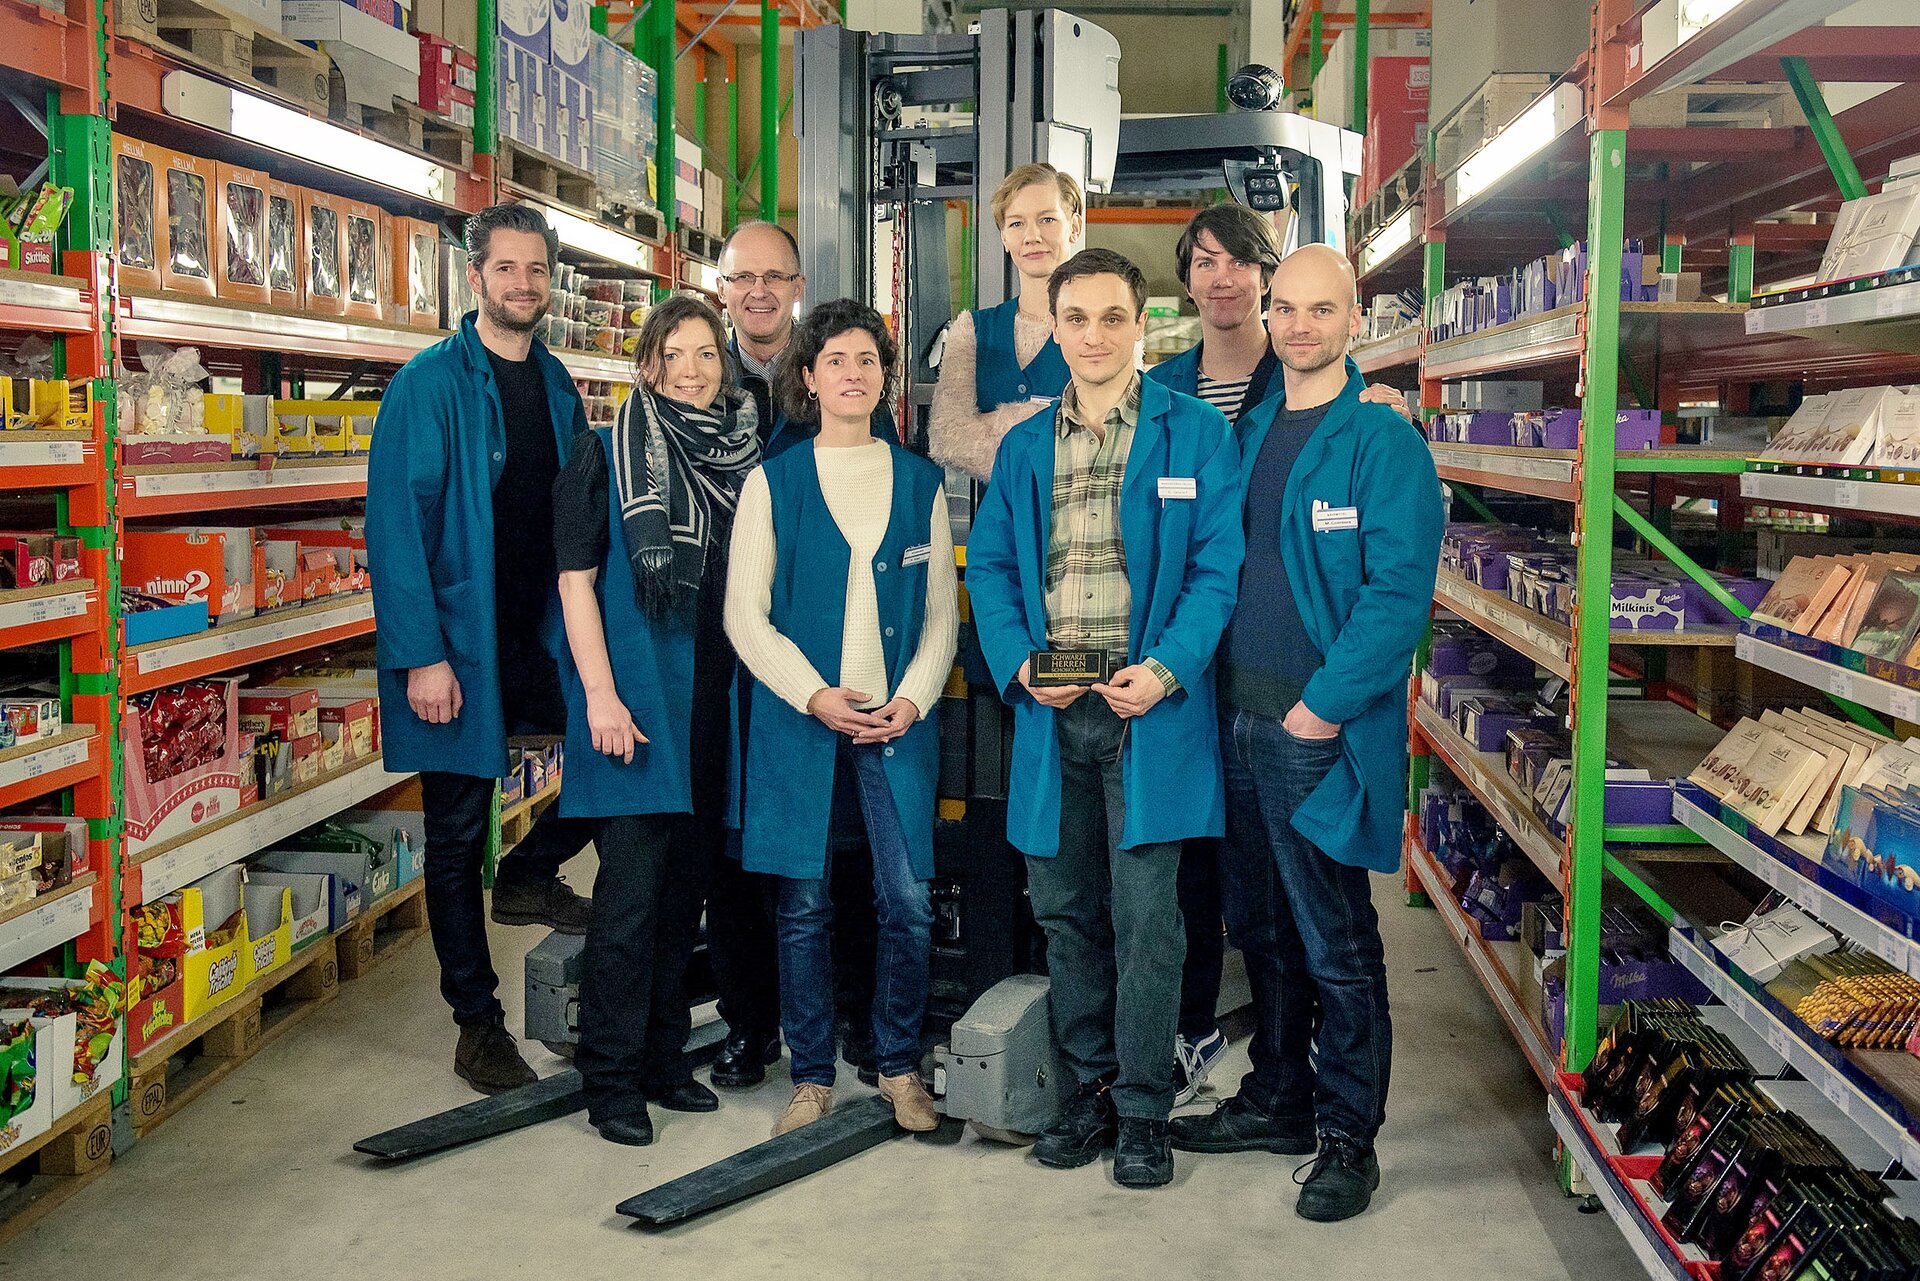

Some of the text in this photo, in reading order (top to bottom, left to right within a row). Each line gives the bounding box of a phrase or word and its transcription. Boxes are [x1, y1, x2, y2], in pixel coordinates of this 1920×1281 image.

[122, 141, 144, 158] HELLMA
[173, 156, 195, 173] HELLMA
[233, 171, 254, 185] HELLMA
[25, 251, 50, 264] Skittles
[1611, 602, 1655, 613] Milkinis
[1611, 971, 1647, 988] Milka
[91, 1129, 106, 1156] EUR
